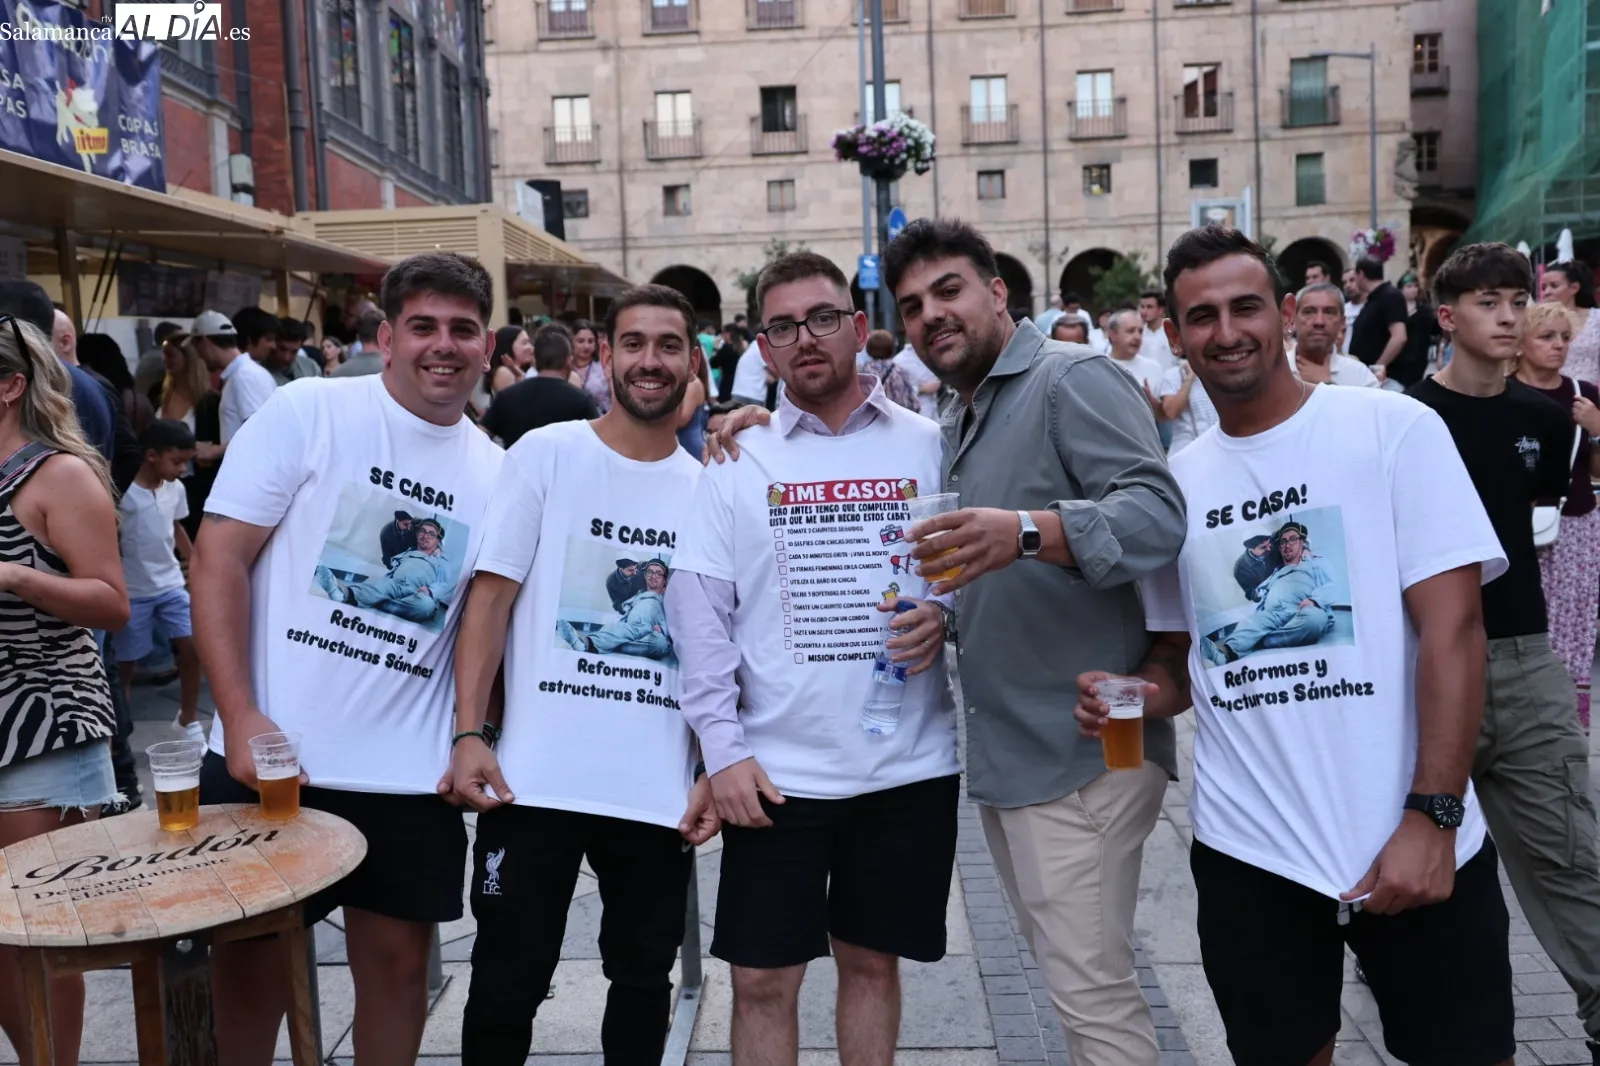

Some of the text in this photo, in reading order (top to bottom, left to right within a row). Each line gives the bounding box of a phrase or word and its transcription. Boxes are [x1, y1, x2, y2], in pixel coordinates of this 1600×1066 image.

[118, 114, 159, 137] COPAS
[369, 467, 454, 512] SE CASA!
[788, 481, 898, 503] ¡ME CASO!
[769, 507, 788, 517] PERO
[790, 505, 813, 515] ANTES
[815, 504, 840, 514] TENGO
[842, 503, 856, 512] QUE
[858, 502, 900, 512] COMPLETAR
[769, 517, 787, 527] LISTA
[789, 515, 803, 525] QUE
[805, 515, 818, 524] ME
[820, 514, 835, 523] HAN
[838, 513, 861, 522] HECHO
[863, 512, 885, 521] ESTOS
[1206, 484, 1308, 529] SE CASA!
[590, 517, 677, 549] SE CASA!
[330, 608, 418, 654] Reformas y
[286, 627, 381, 666] estructuras
[808, 654, 836, 662] MISION
[577, 657, 662, 687] Reformas y
[1224, 659, 1328, 690] Reformas y
[538, 679, 633, 702] estructuras
[1293, 678, 1375, 702] Sánchez
[10, 828, 280, 890] Bordón
[32, 855, 232, 900] Descaradamente
